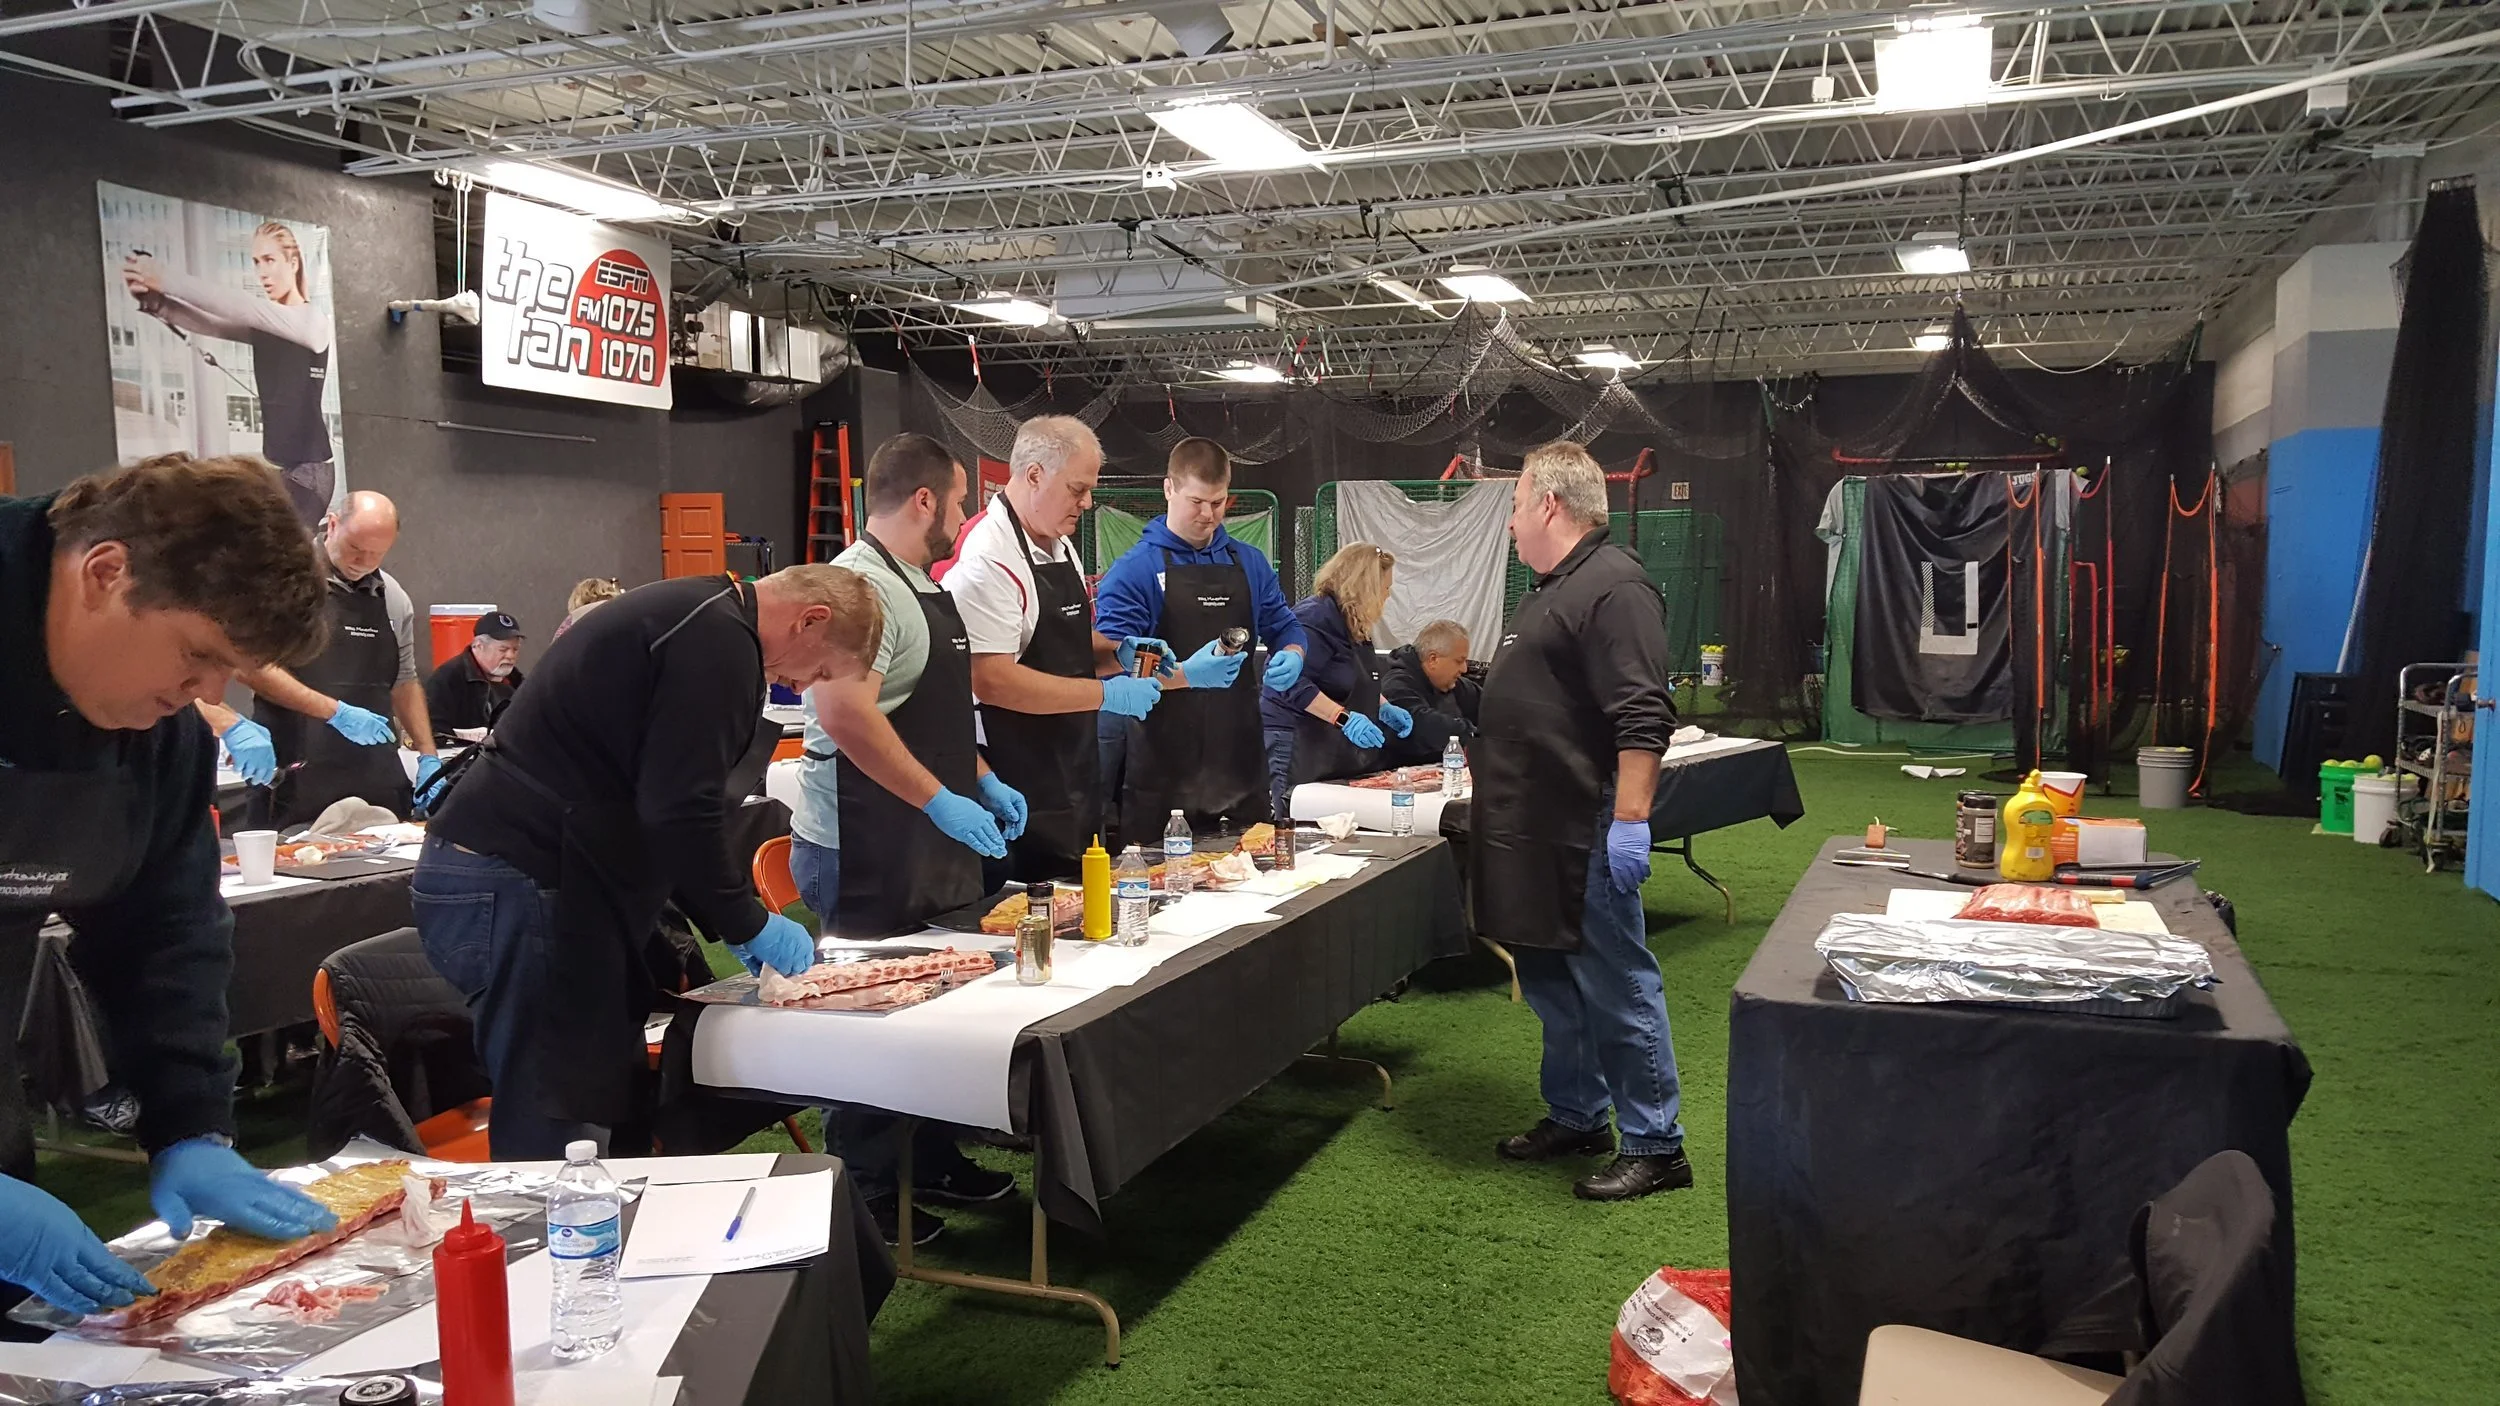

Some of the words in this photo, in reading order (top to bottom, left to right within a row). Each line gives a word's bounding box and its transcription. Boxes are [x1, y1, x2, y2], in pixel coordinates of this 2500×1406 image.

[486, 236, 574, 316] the
[595, 258, 649, 294] ESPN
[508, 296, 591, 376] fan
[601, 337, 656, 385] 1070
